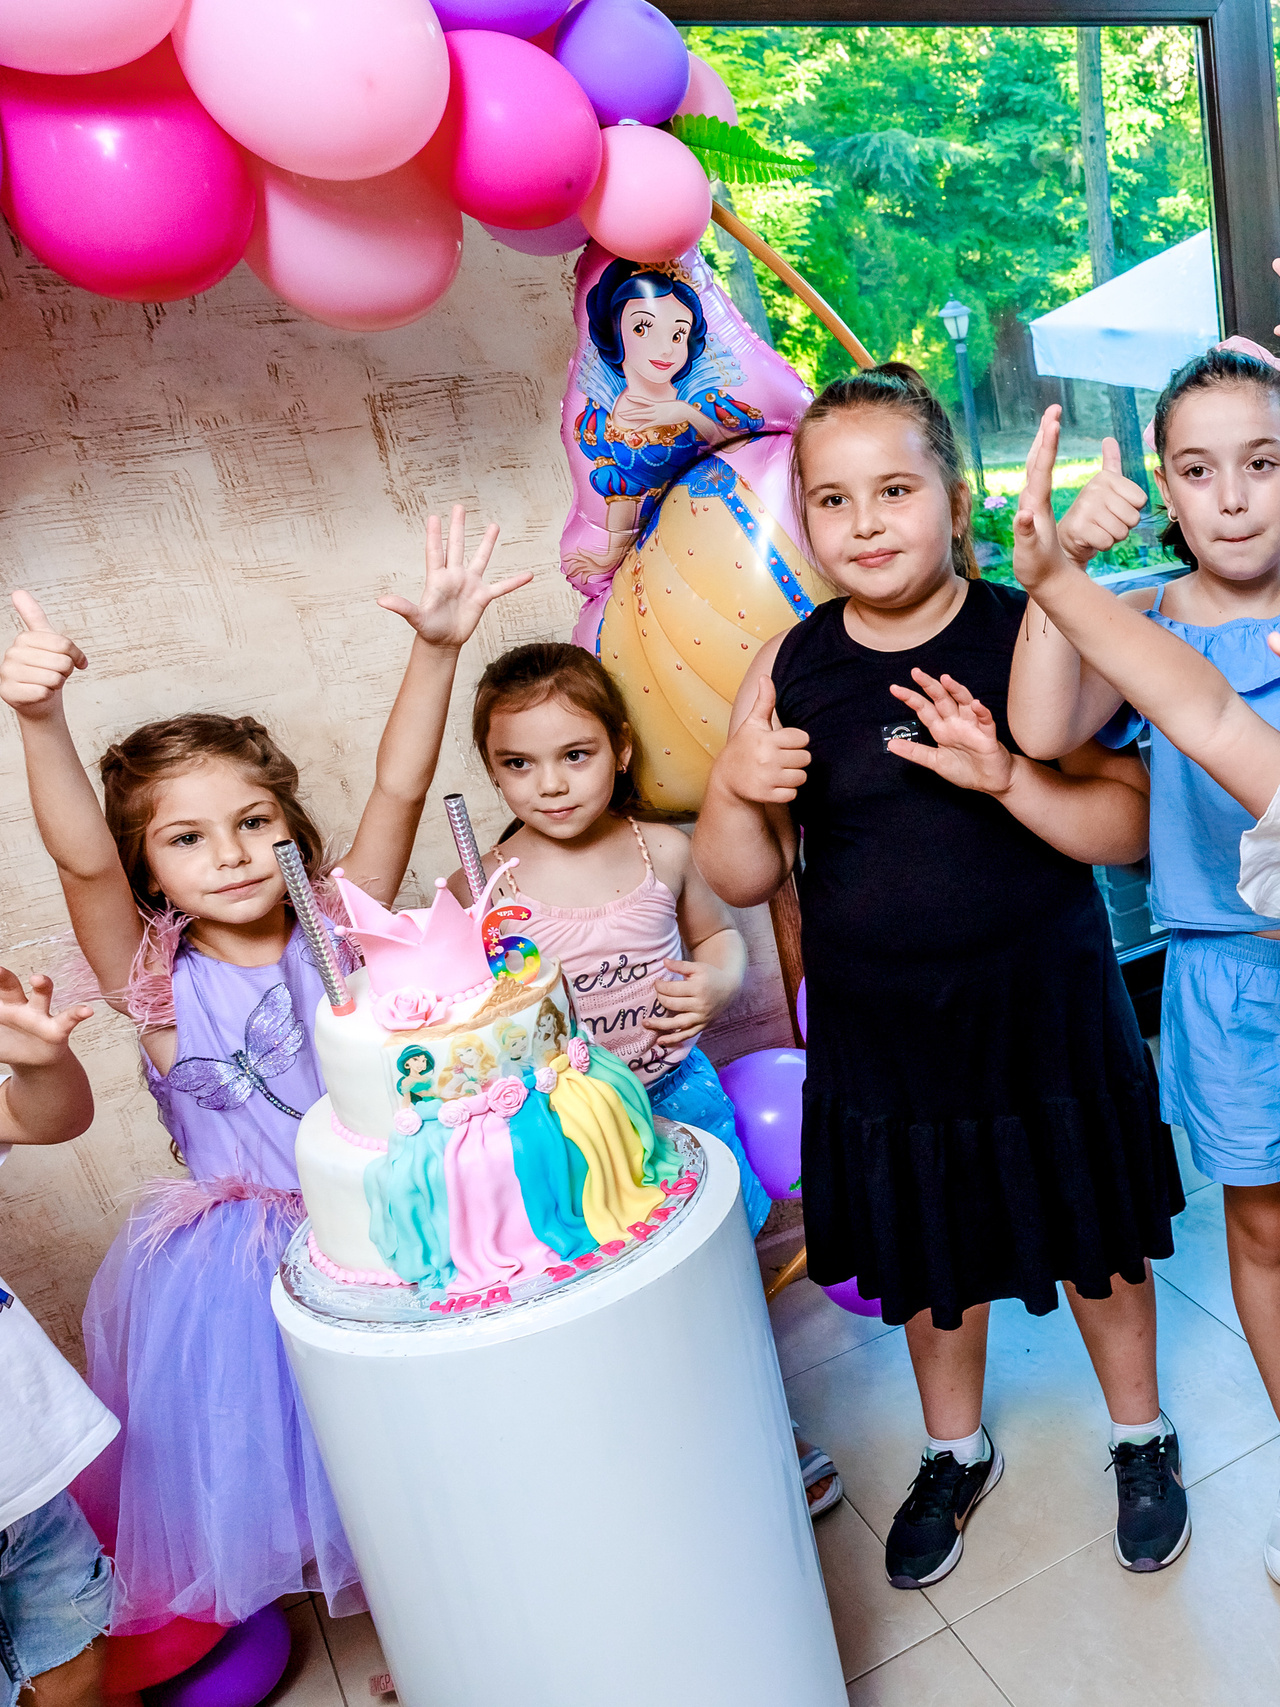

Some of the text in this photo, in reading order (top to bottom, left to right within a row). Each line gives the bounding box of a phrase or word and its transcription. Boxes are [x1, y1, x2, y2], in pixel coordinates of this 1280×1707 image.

[496, 909, 514, 917] ЧРД
[572, 954, 657, 992] ello
[429, 1285, 513, 1315] ЧРД
